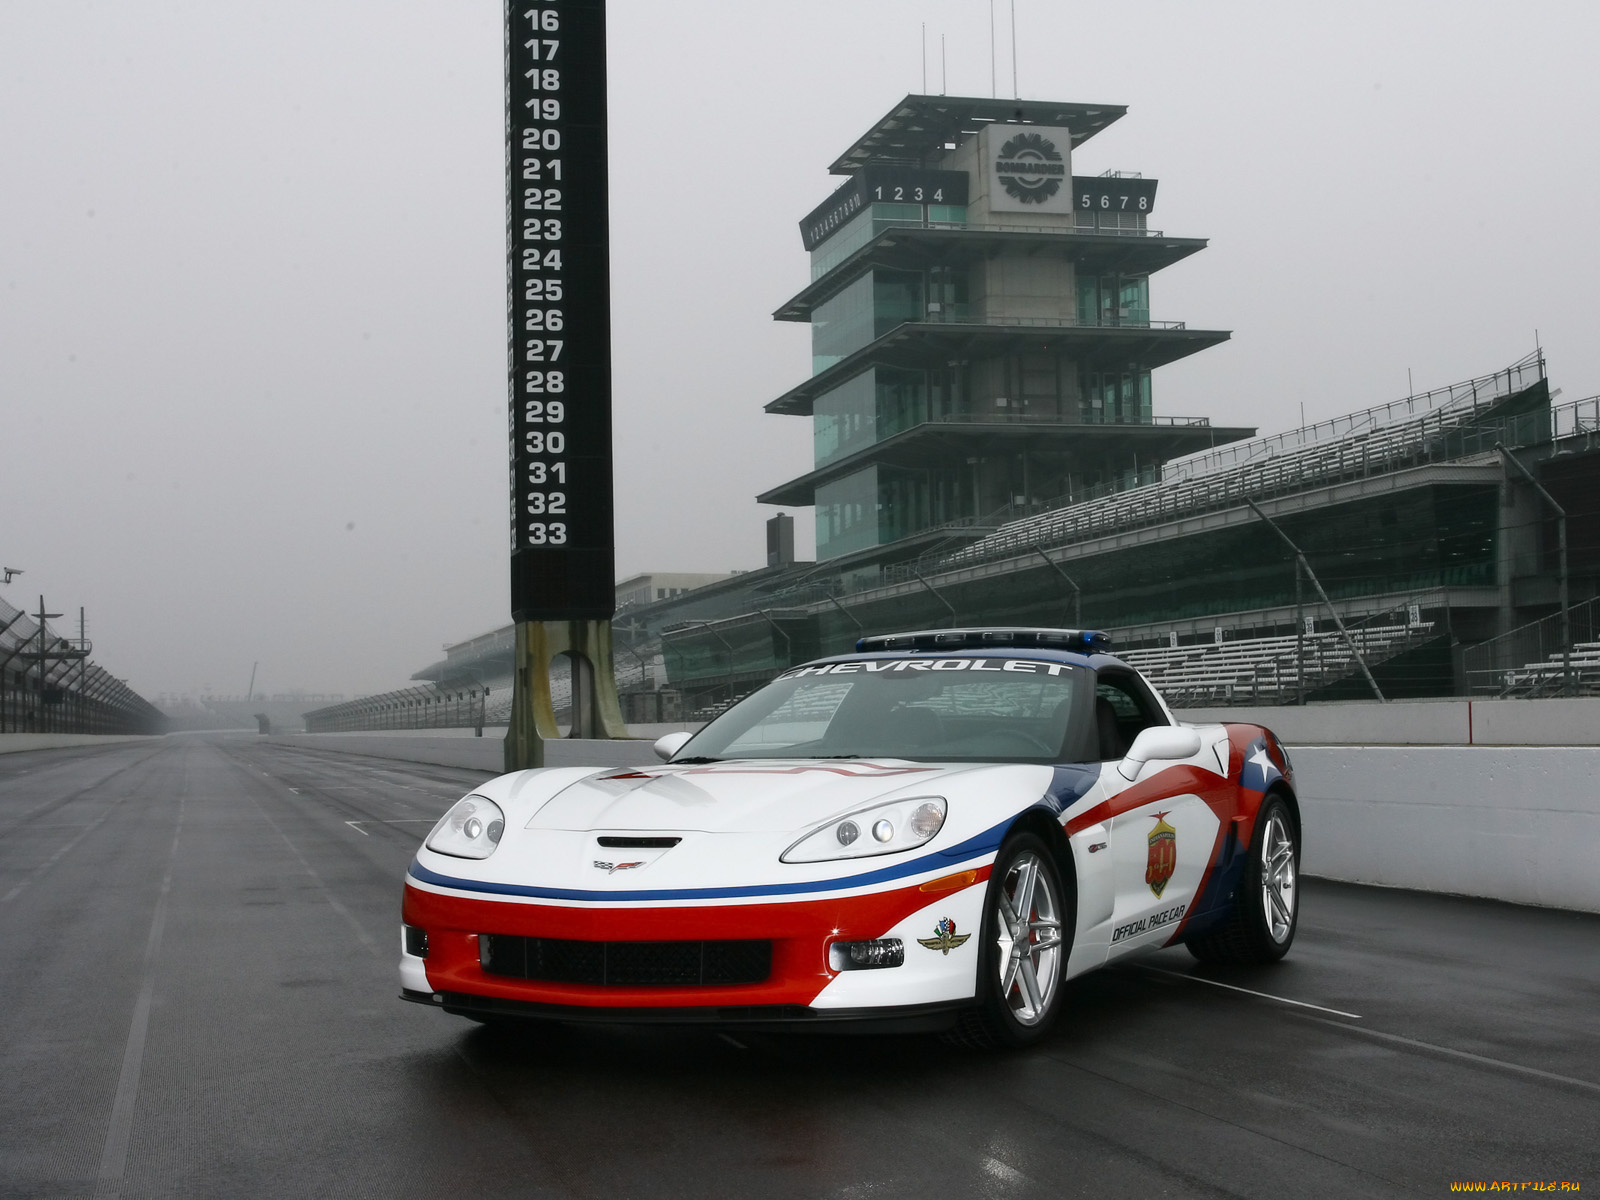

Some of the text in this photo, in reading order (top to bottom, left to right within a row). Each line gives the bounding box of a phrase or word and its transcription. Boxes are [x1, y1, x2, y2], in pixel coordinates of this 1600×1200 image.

[524, 10, 559, 31] 16
[525, 39, 559, 60] 17
[525, 69, 559, 90] 18
[525, 99, 560, 120] 19
[523, 128, 560, 150] 20
[524, 158, 561, 180] 21
[996, 161, 1065, 176] BOMBARDIER
[525, 188, 561, 210] 22
[875, 186, 943, 202] 1 2 3 4
[1082, 195, 1148, 210] 5 6 7 8
[524, 219, 561, 240] 23
[523, 249, 562, 270] 24
[526, 279, 562, 300] 25
[526, 309, 563, 331] 26
[527, 340, 563, 361] 27
[527, 371, 564, 392] 28
[526, 401, 564, 423] 29
[526, 432, 564, 453] 30
[529, 462, 565, 484] 31
[528, 492, 565, 514] 32
[529, 523, 566, 545] 33
[782, 659, 1073, 680] CHEVROLET
[1112, 904, 1185, 942] OFFICIAL PACE CAR
